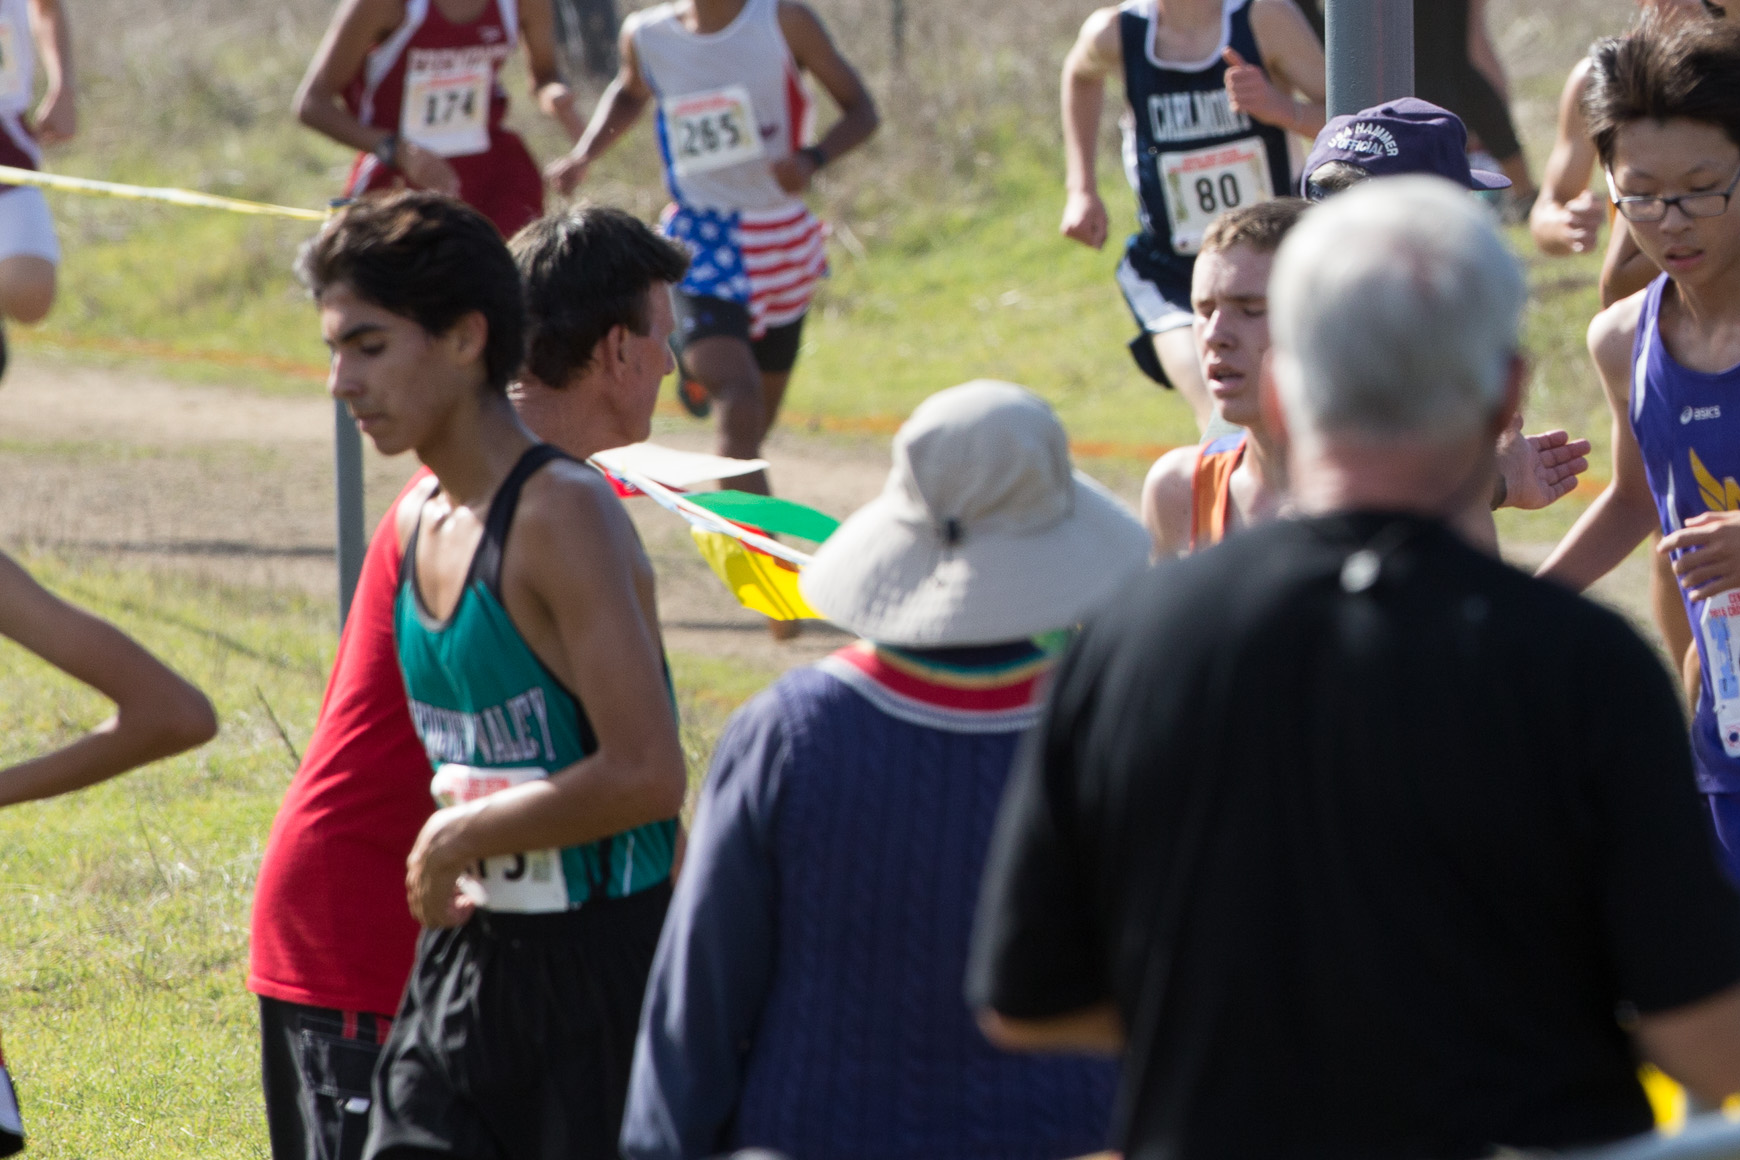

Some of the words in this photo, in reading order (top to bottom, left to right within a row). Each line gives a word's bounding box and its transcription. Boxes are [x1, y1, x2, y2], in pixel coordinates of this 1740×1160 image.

[1337, 139, 1383, 155] OFFICIAL
[1355, 122, 1399, 156] HAMMER
[1196, 173, 1241, 213] 80
